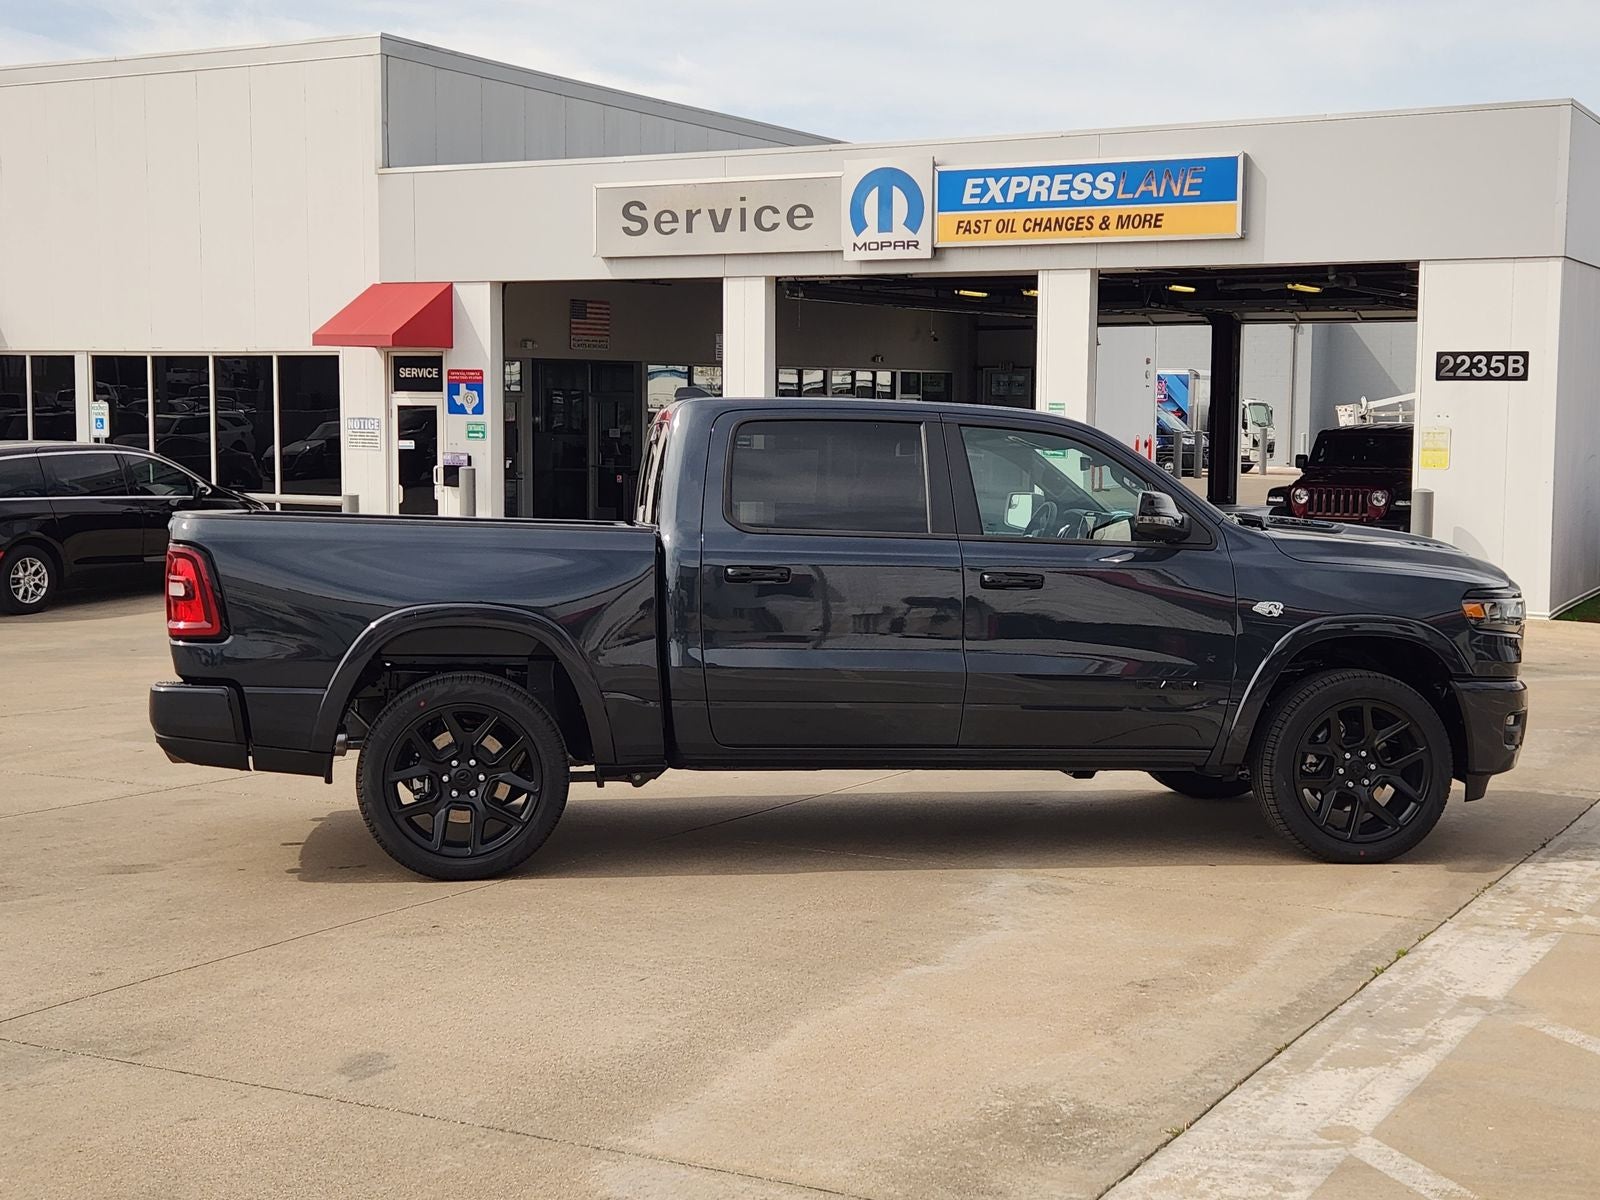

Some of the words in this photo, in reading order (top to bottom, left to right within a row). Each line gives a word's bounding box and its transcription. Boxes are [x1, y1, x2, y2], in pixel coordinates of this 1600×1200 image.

[621, 196, 814, 237] Service
[955, 219, 992, 235] FAST
[995, 218, 1017, 234] OIL
[1022, 215, 1095, 233] CHANGES
[1098, 215, 1111, 231] &
[1115, 213, 1164, 230] MORE
[853, 239, 920, 252] MOPAR
[399, 367, 439, 378] SERVICE
[1439, 354, 1525, 377] 2235B
[347, 418, 380, 430] NOTICE
